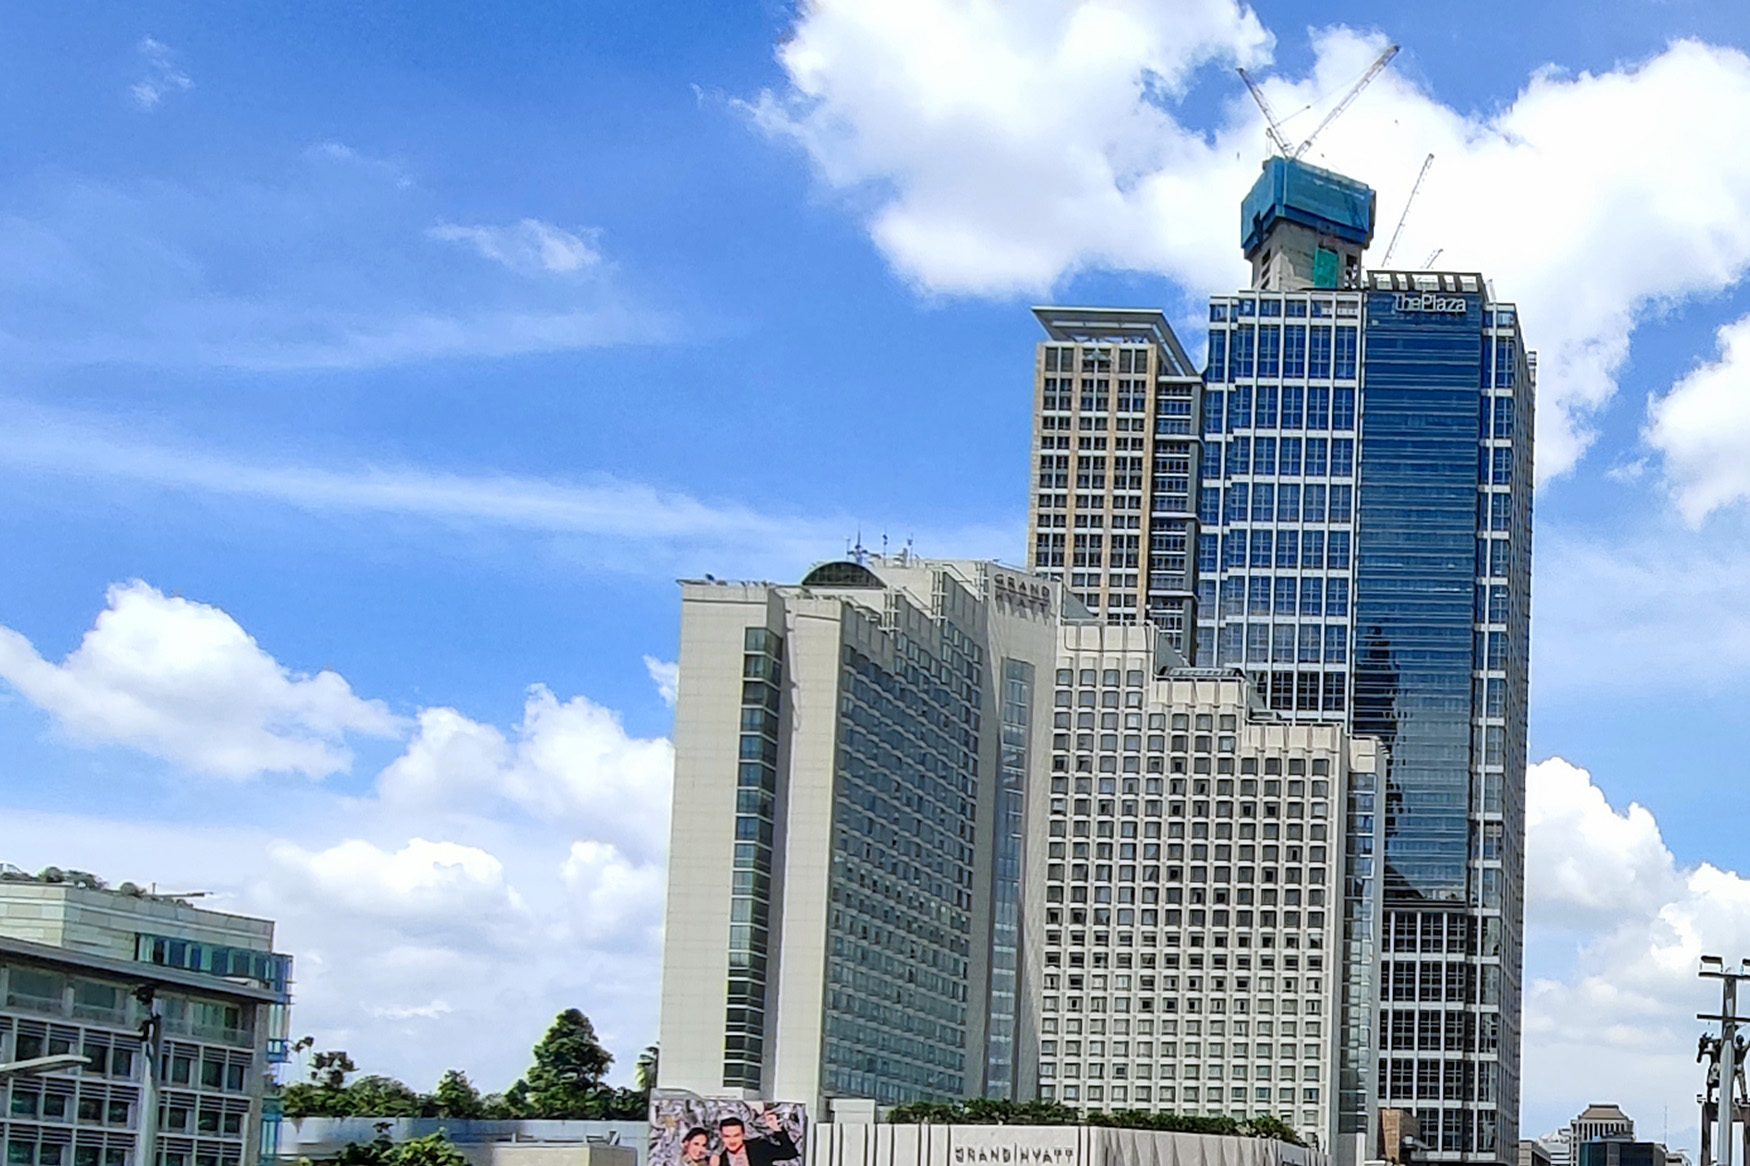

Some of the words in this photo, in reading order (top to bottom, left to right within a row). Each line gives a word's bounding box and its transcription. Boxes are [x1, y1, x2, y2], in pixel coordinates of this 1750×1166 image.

[994, 573, 1050, 597] GRAND
[995, 589, 1049, 611] HYATT
[955, 1146, 1011, 1163] GRAND
[1020, 1146, 1073, 1164] HYATT
